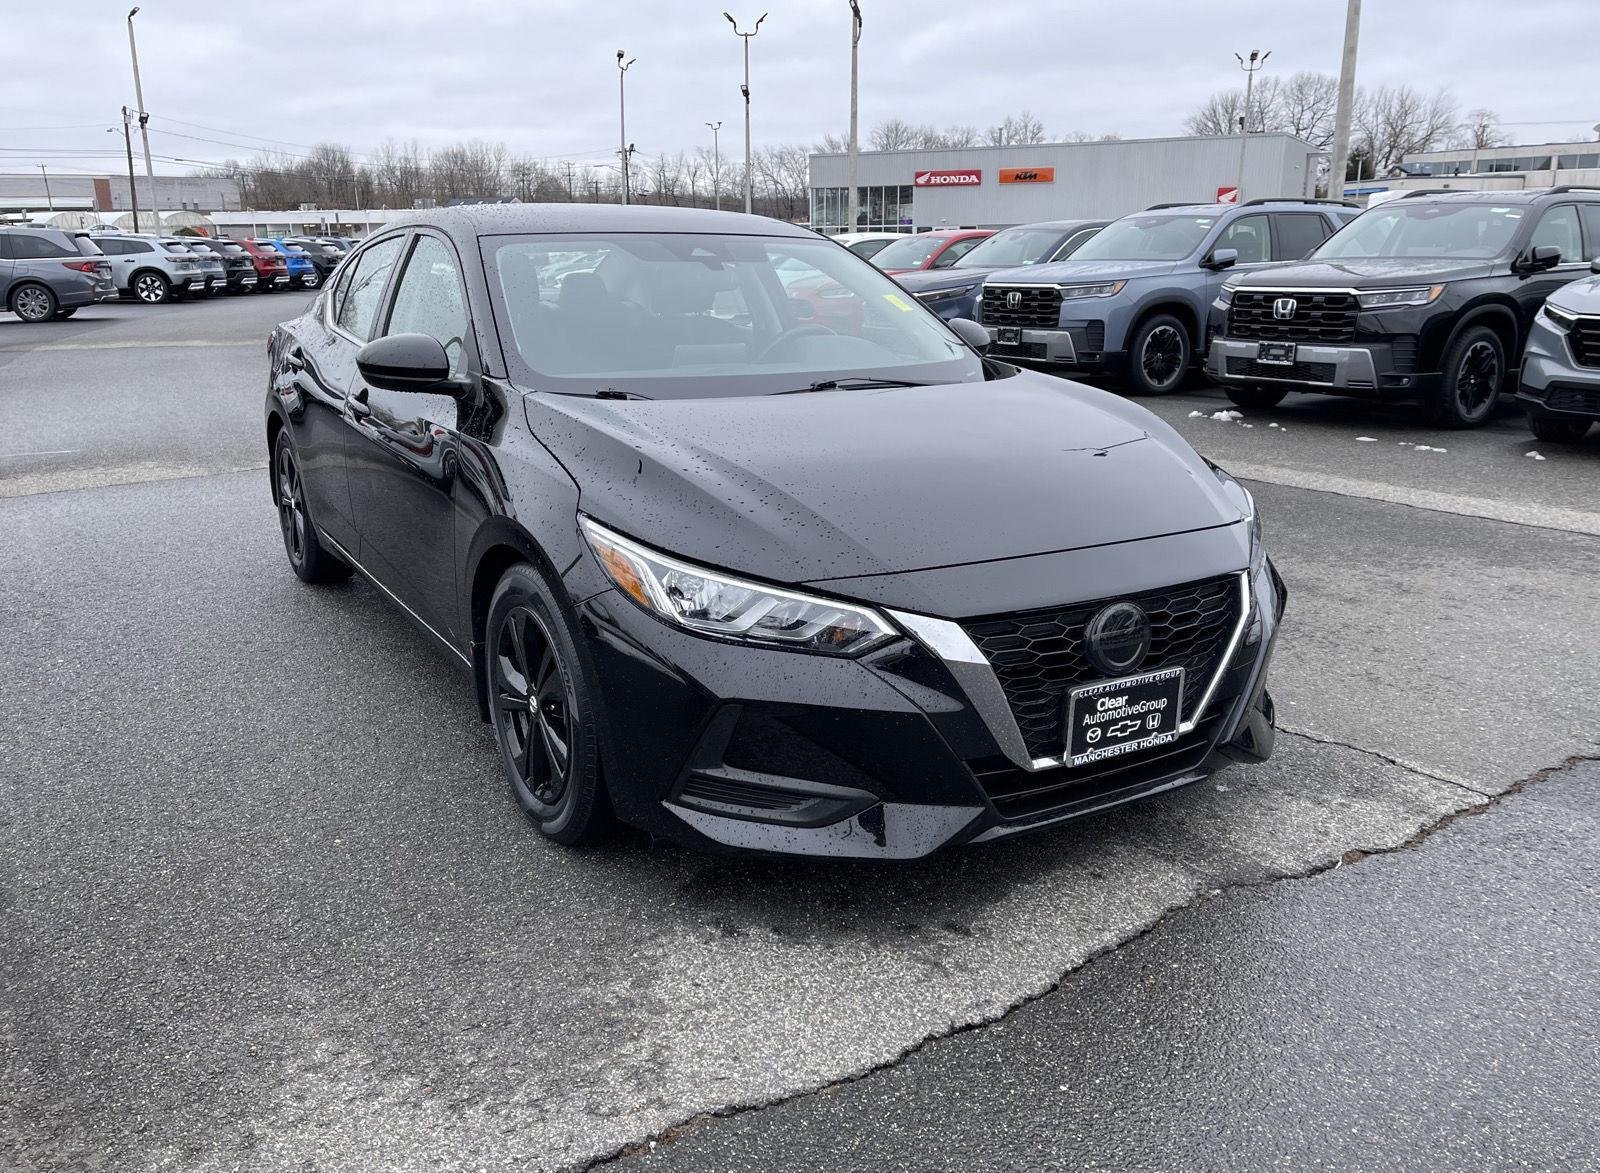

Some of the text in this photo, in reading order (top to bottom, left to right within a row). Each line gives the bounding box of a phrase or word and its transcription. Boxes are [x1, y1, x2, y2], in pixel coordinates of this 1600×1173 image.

[930, 174, 979, 184] HONDA
[1014, 171, 1038, 181] KTM
[1079, 670, 1180, 697] CLEAR AUTOMOTIVE GROUP
[1083, 698, 1167, 726] AutomotiveGroup
[1097, 695, 1129, 711] Clear
[1074, 735, 1172, 766] MANCHESTER HONDA
